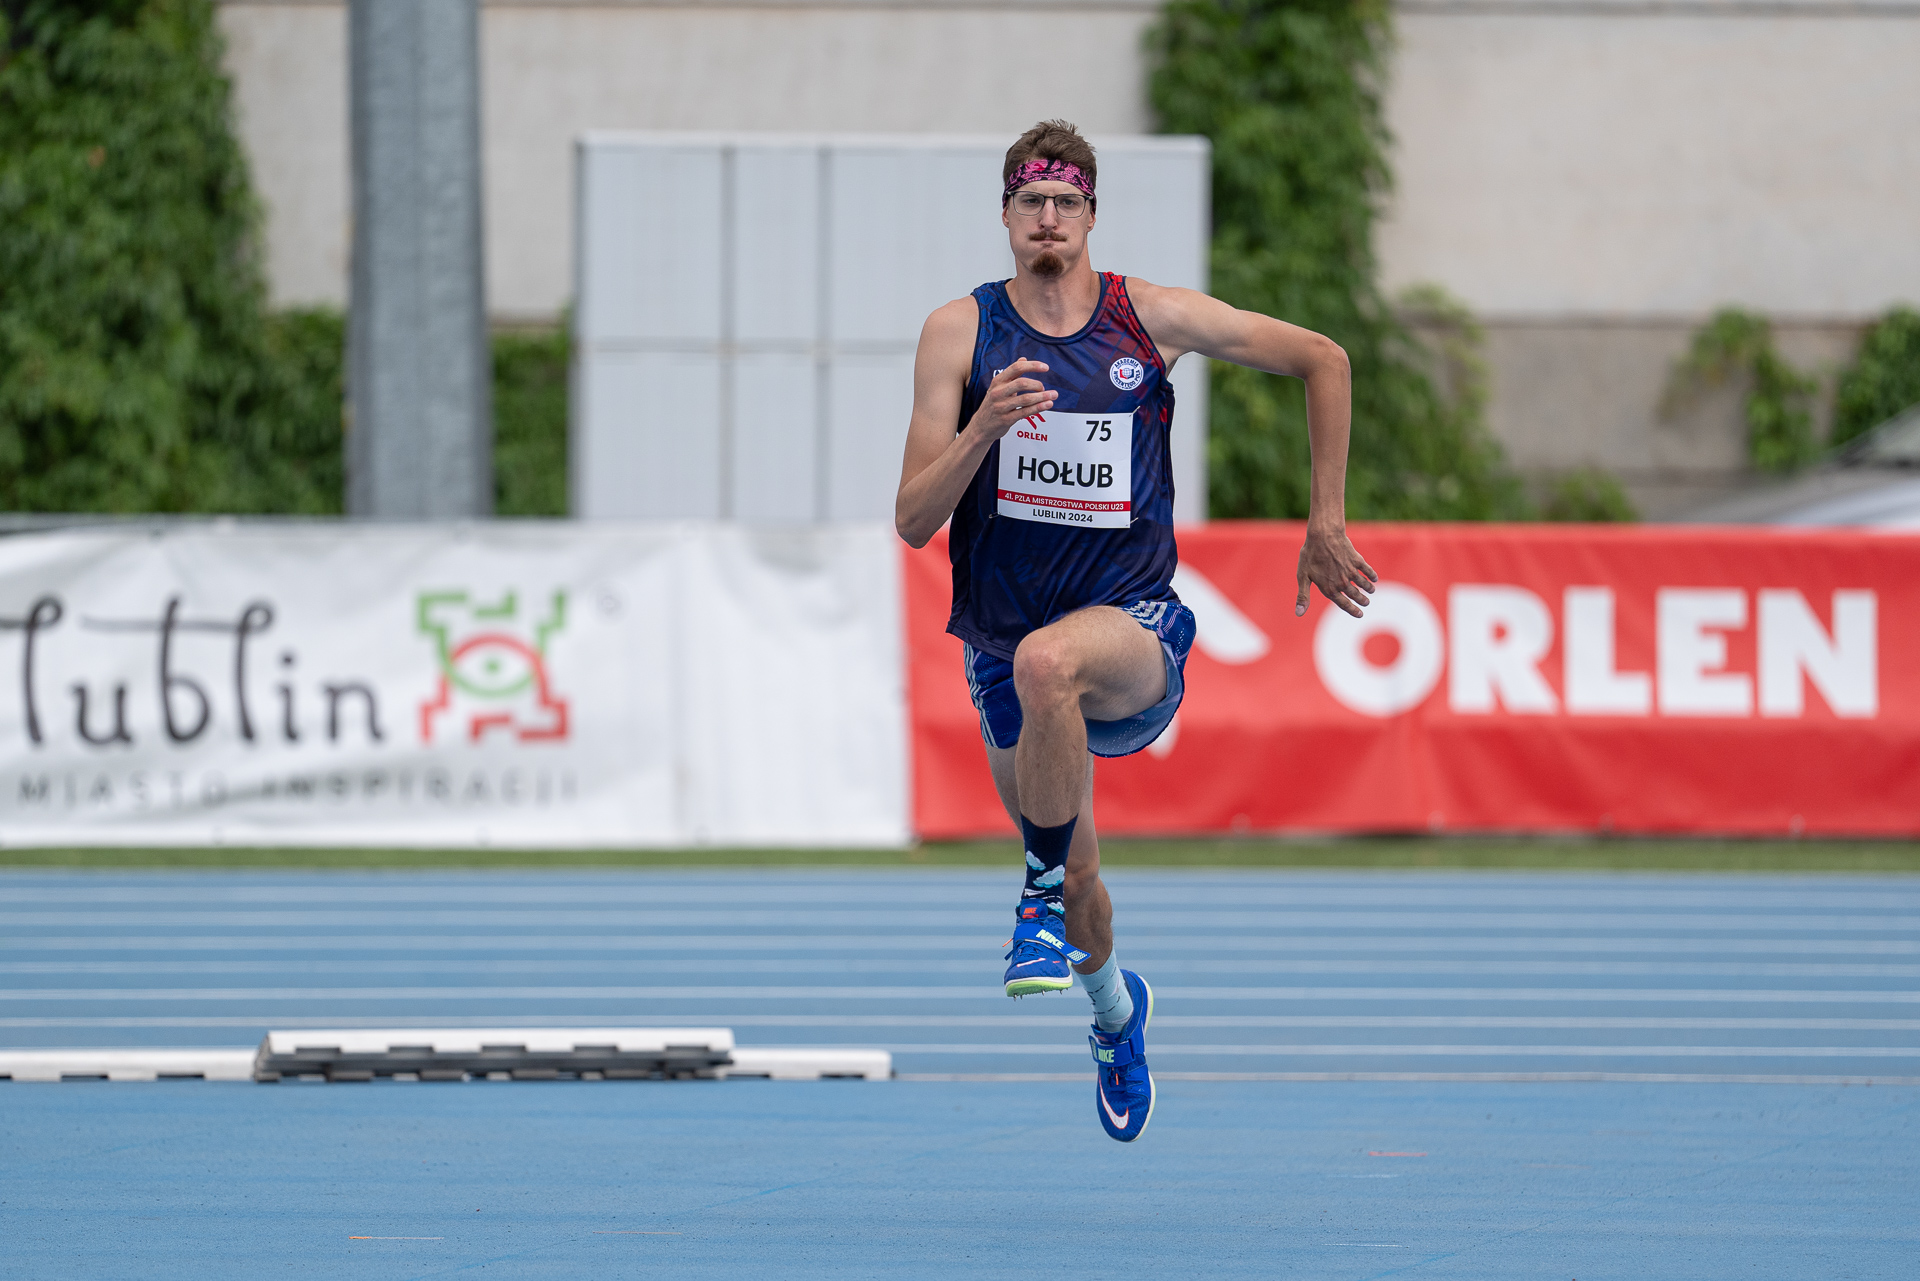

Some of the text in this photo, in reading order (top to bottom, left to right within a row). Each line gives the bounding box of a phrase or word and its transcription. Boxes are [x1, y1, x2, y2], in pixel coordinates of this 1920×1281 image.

[1016, 430, 1048, 442] ORLEN
[1086, 420, 1112, 442] 75
[1017, 455, 1114, 488] HOŁUB
[1004, 492, 1124, 511] 41. PZLA MISTRZOSTWA POLSKI U23
[1032, 508, 1094, 523] LUBLIN 2024
[1312, 578, 1880, 719] ORLEN
[1035, 928, 1065, 950] NIKE
